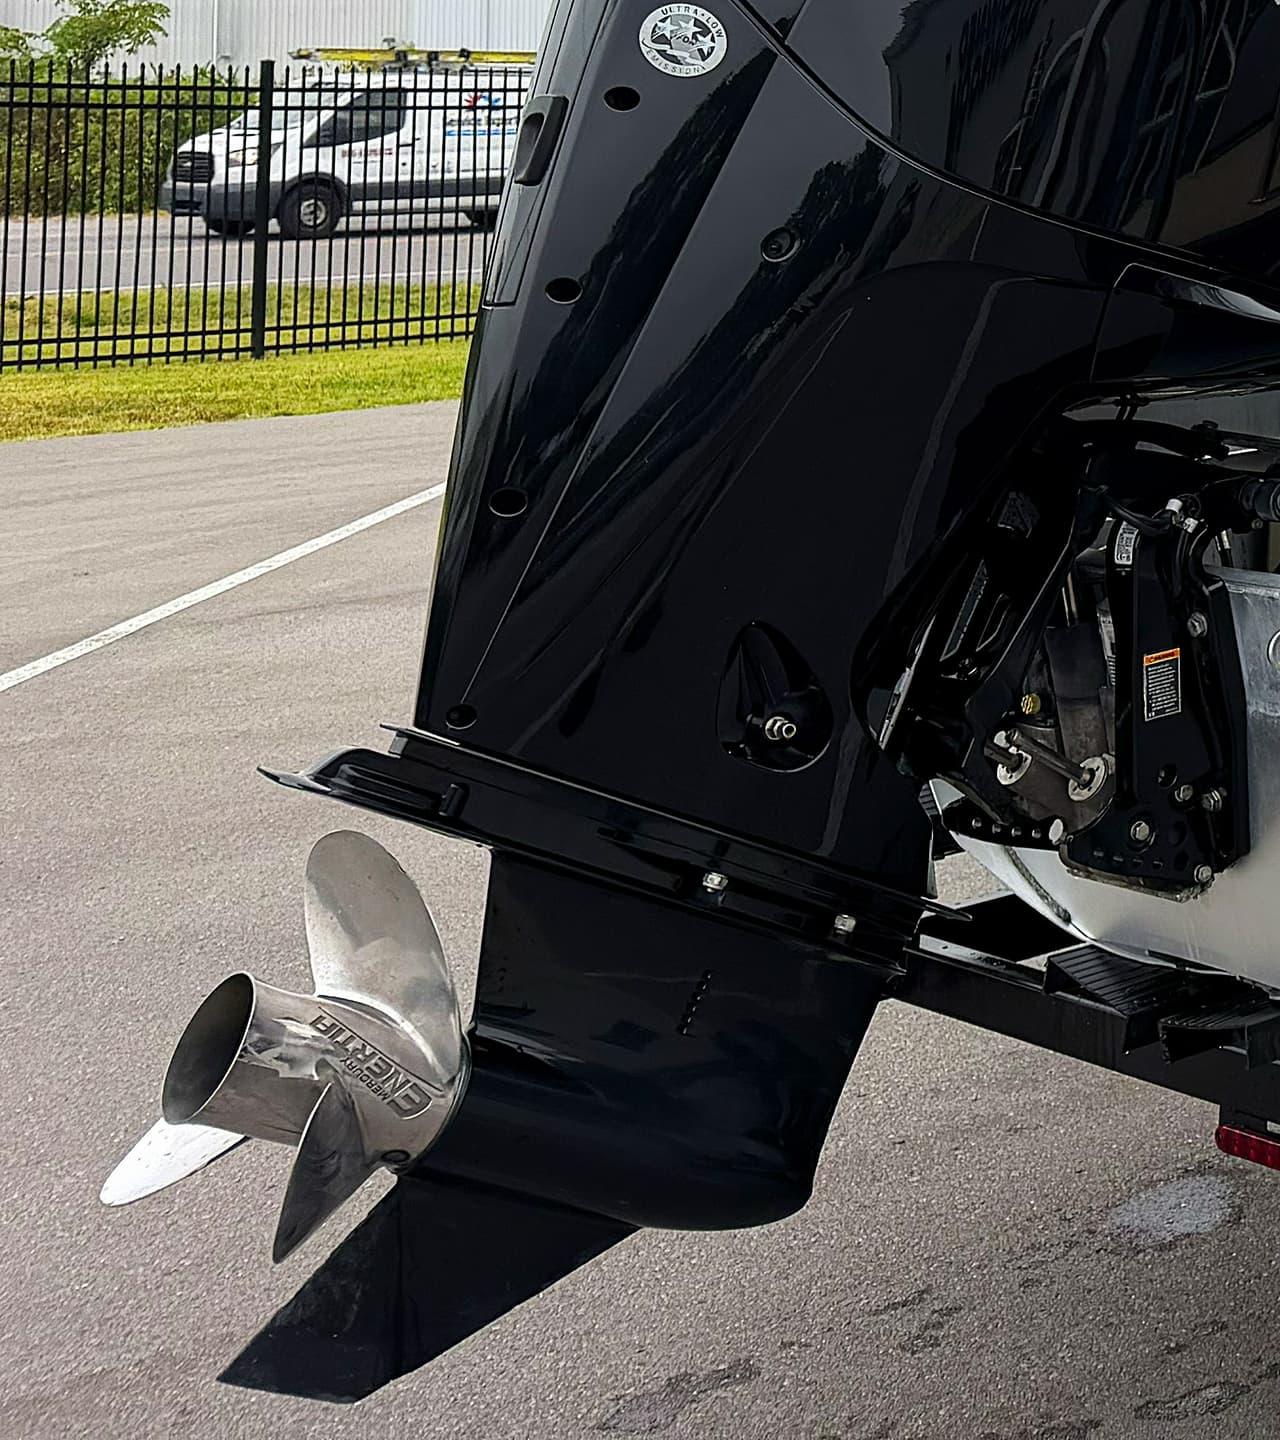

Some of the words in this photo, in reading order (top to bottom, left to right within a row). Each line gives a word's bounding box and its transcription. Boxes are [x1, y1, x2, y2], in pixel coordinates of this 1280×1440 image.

[660, 5, 699, 17] ULTRA
[705, 16, 725, 38] LOW
[310, 1015, 433, 1120] ENERTIA
